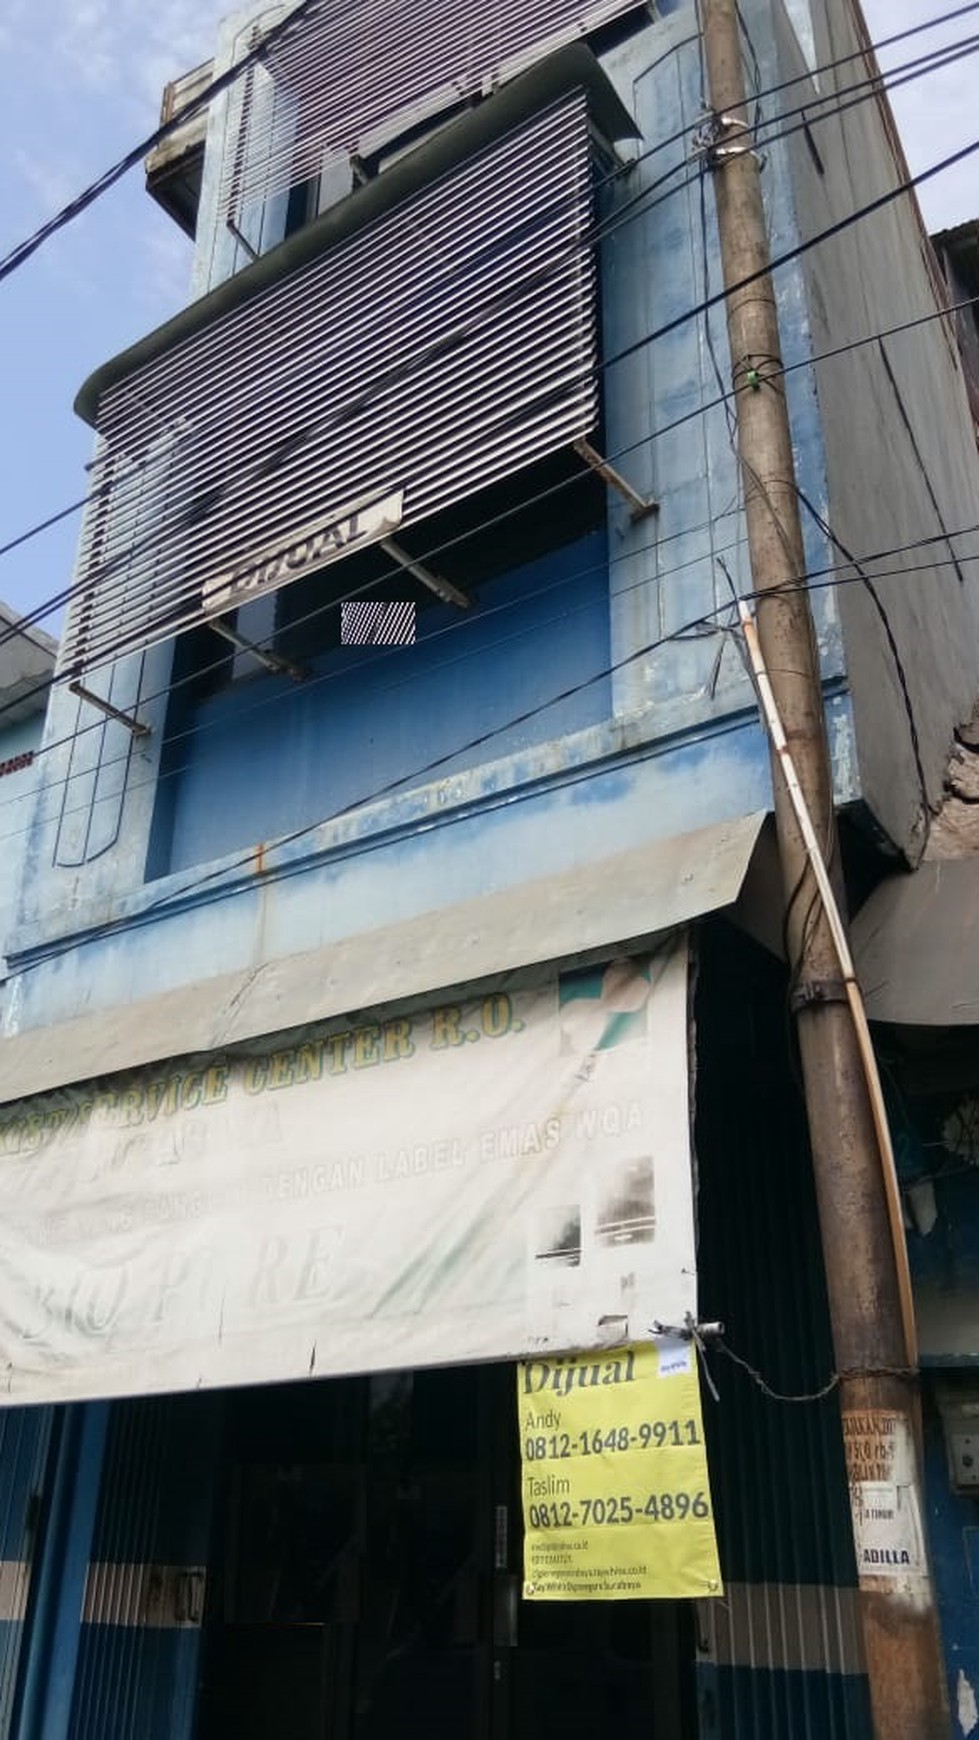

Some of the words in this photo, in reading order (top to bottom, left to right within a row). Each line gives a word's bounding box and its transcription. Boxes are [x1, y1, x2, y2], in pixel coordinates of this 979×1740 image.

[242, 1021, 414, 1097] CENTER
[431, 992, 527, 1051] R.O.
[374, 1138, 467, 1182] LABEL
[479, 1118, 562, 1164] EMAS
[521, 1350, 636, 1397] Dijual
[525, 1411, 562, 1431] Andy
[525, 1419, 701, 1461] 0812-1648-9911
[527, 1475, 570, 1497] Taslim
[529, 1491, 709, 1529] 0812-7025-4896
[863, 1548, 910, 1564] ADILLA
